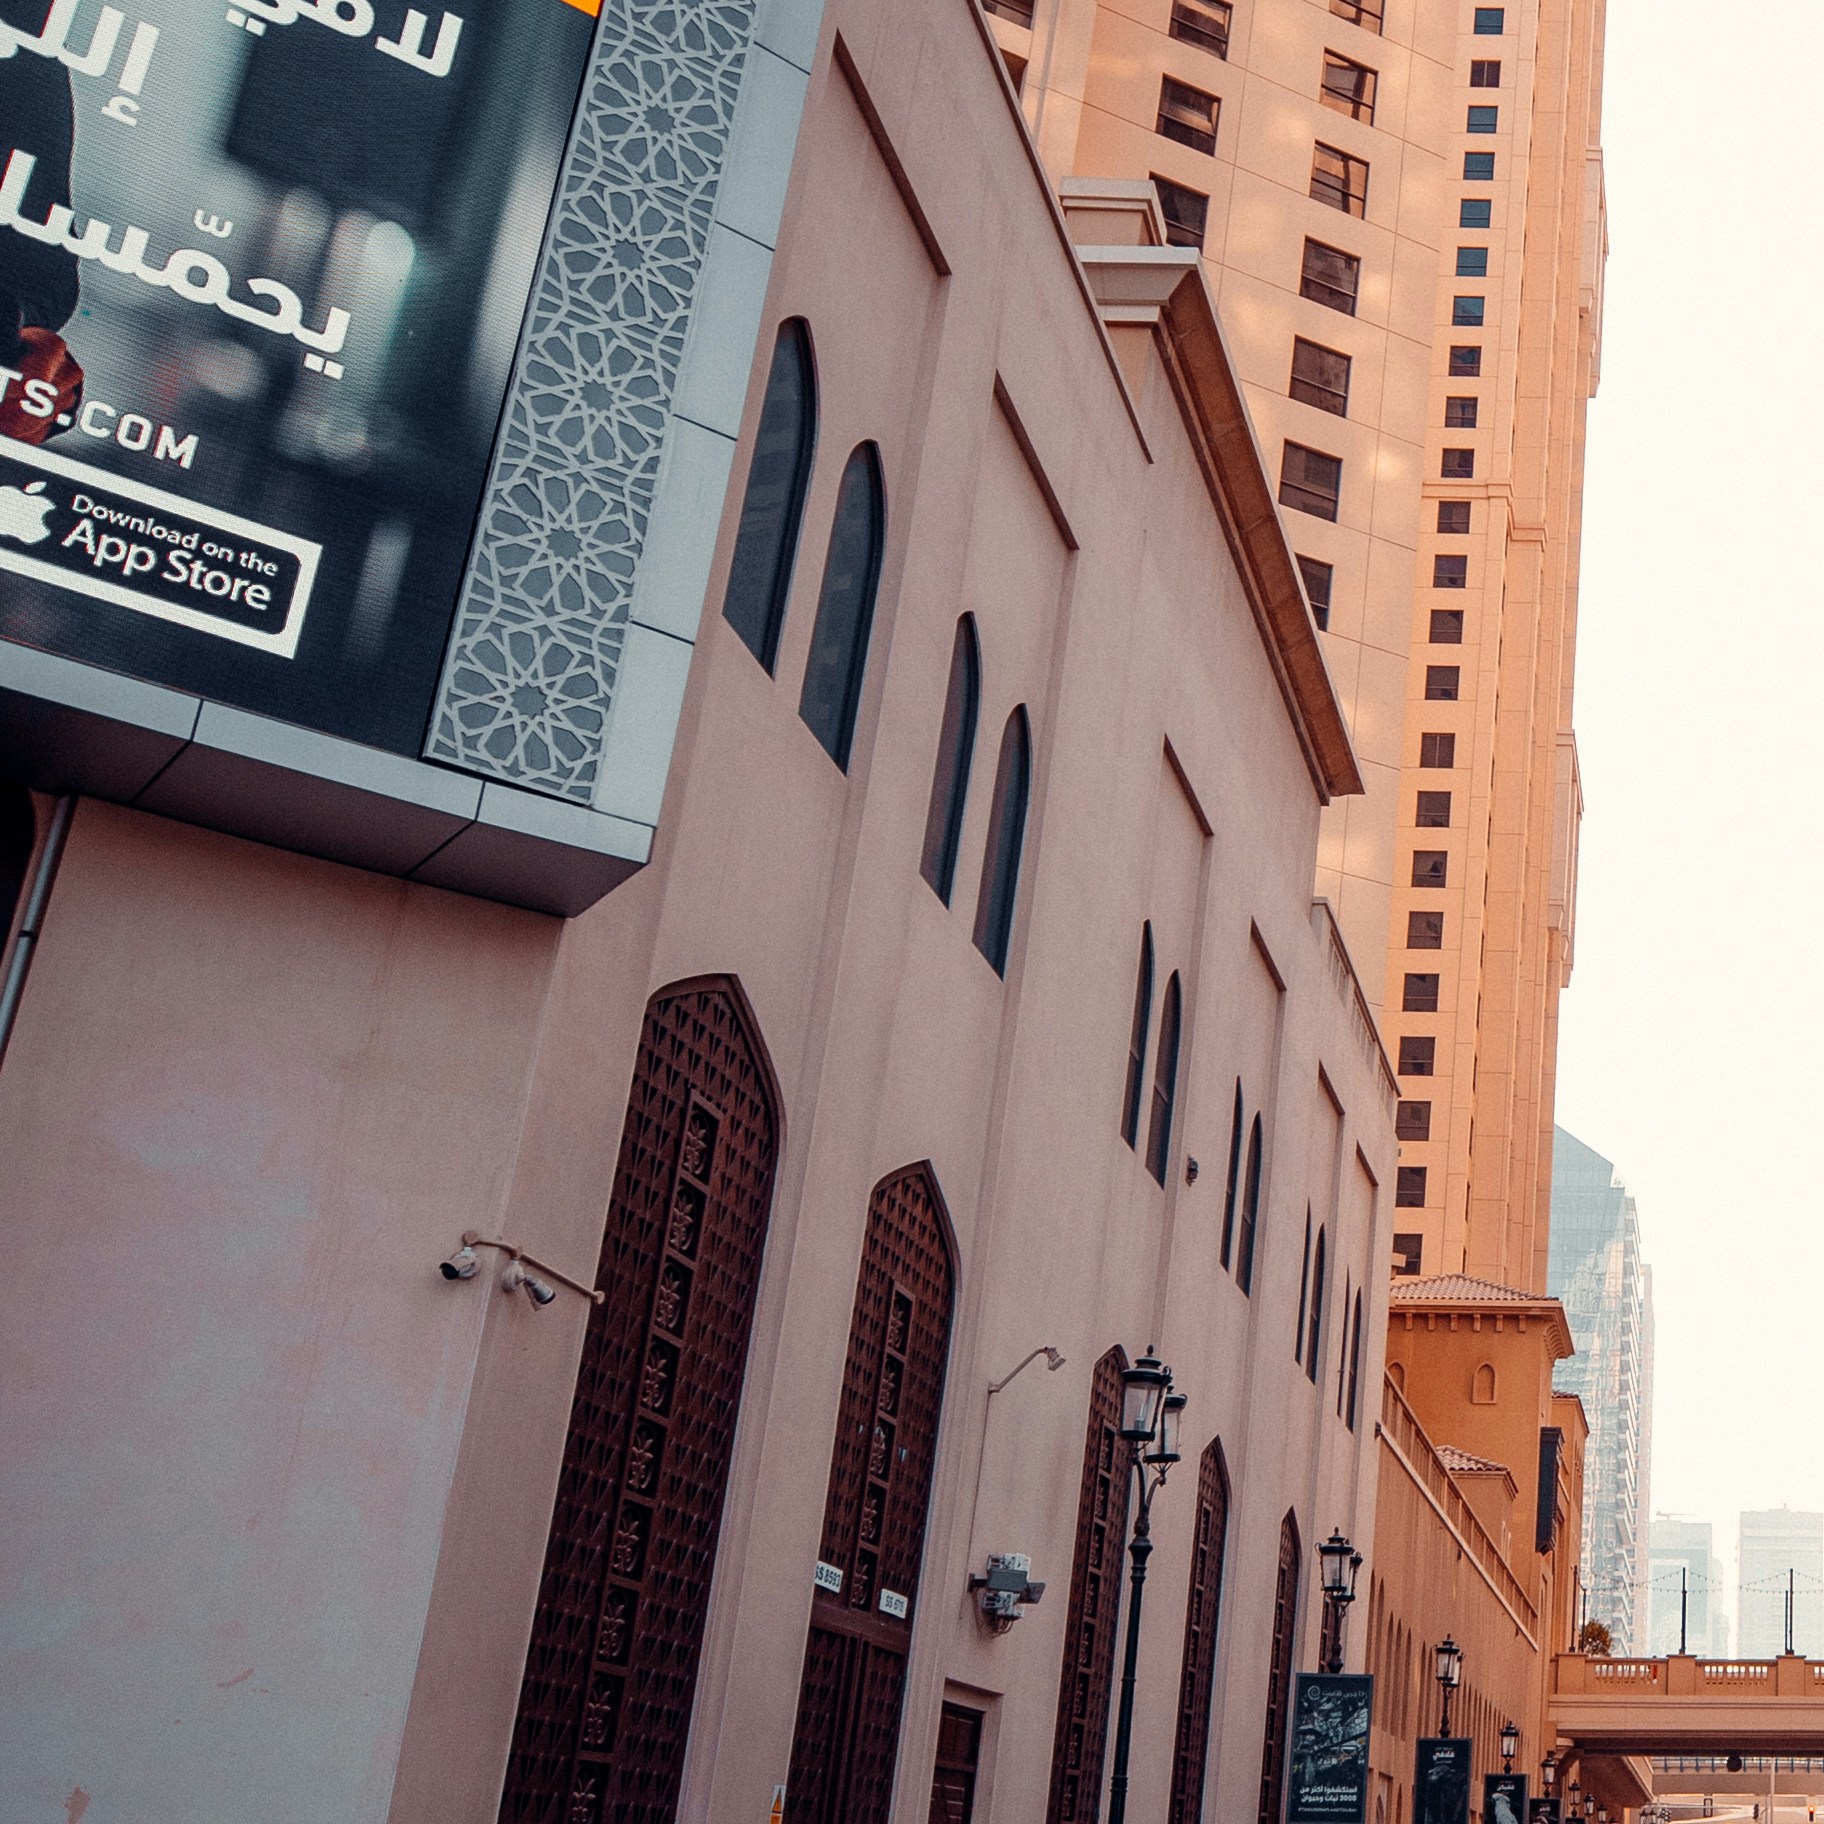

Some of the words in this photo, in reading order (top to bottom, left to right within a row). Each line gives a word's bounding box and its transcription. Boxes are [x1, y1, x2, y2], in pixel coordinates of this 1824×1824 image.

[61, 518, 158, 577] App
[161, 548, 273, 611] Store
[71, 493, 200, 551] Download
[202, 540, 235, 564] on
[239, 551, 280, 578] the
